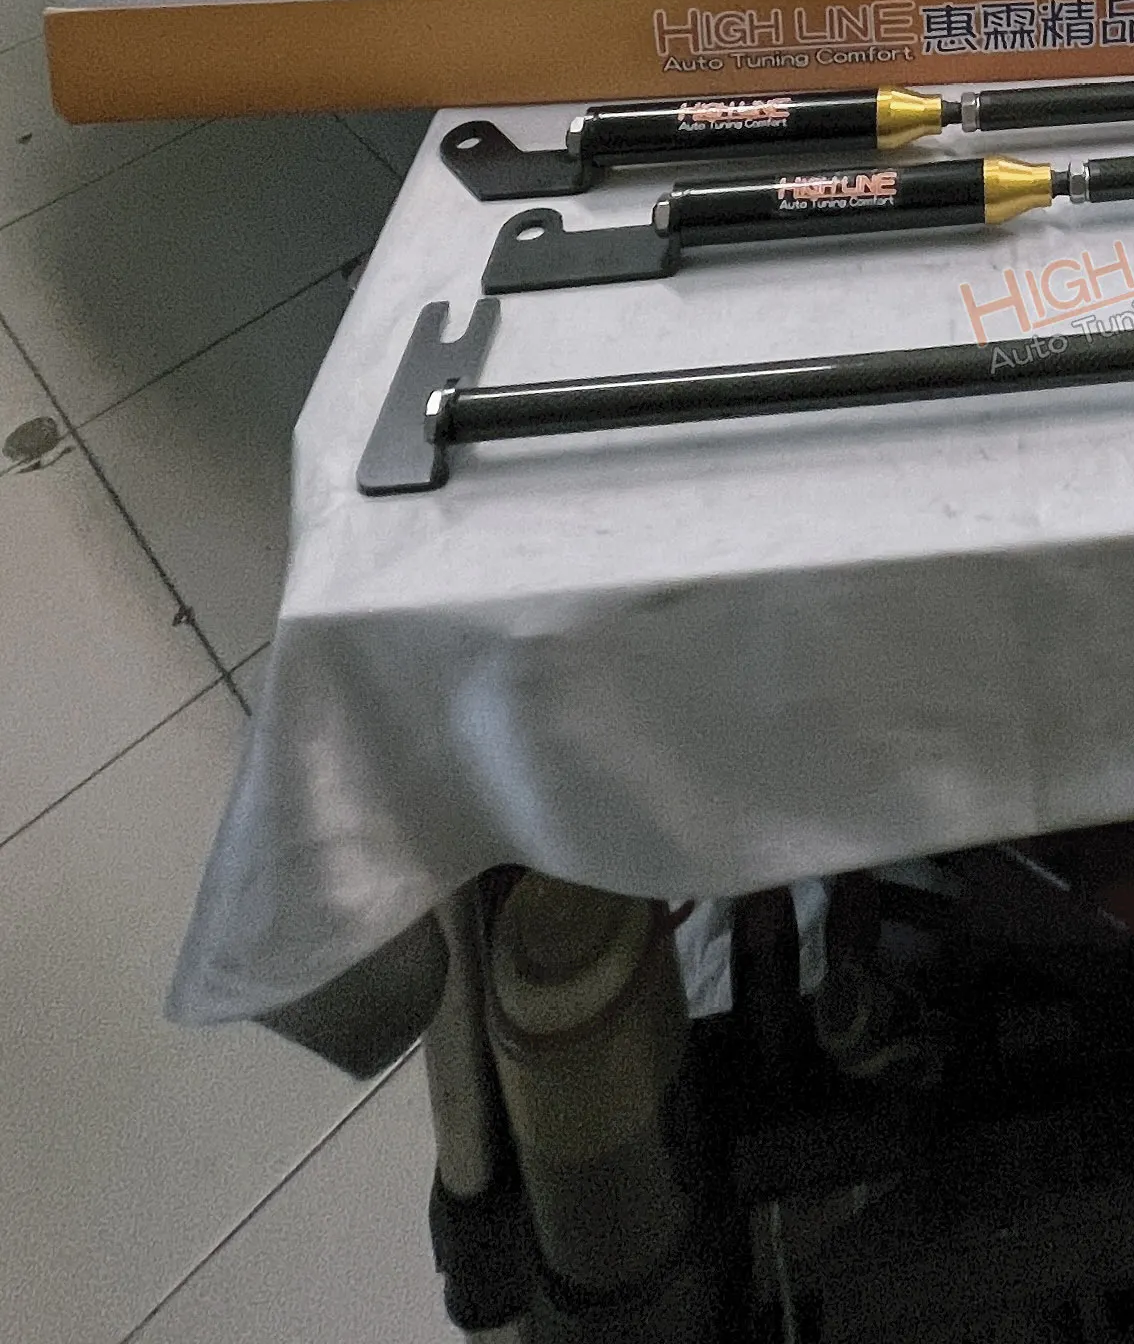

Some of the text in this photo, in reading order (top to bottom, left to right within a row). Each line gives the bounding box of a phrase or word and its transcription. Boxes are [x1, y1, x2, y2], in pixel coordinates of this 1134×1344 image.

[654, 0, 918, 57] HIGH LINE
[663, 45, 914, 73] Auto Tuning Comfort
[779, 195, 894, 210] Auto Tuning Comfort
